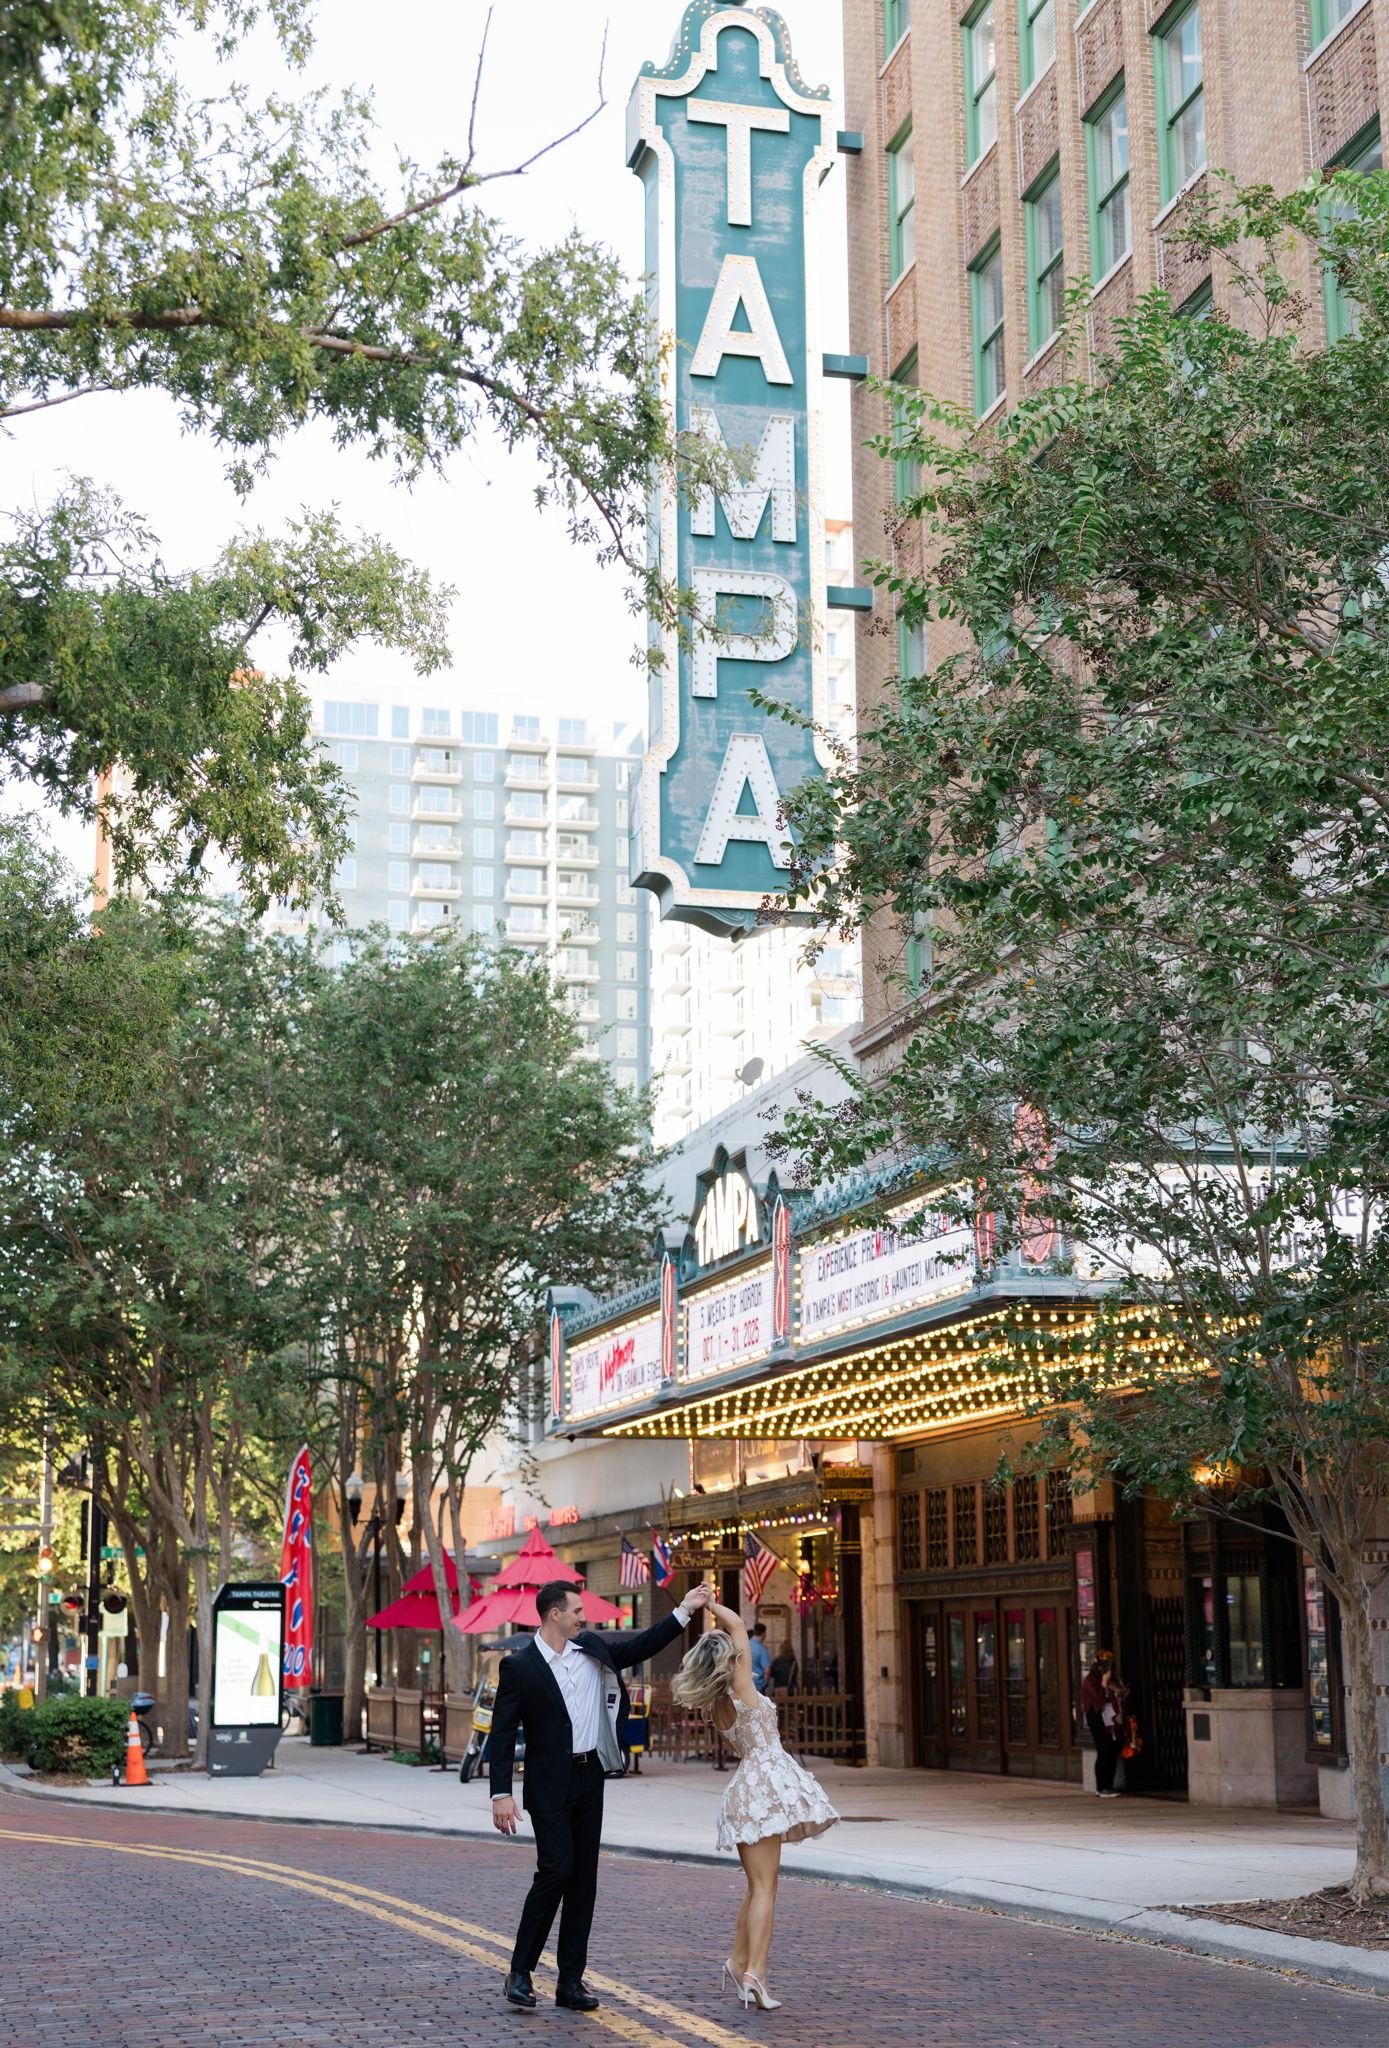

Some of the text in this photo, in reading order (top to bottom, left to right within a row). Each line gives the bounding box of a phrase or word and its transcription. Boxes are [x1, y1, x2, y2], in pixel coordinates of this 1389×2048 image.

[686, 97, 797, 868] TAMPA
[695, 1172, 759, 1266] TAMPA
[817, 1228, 895, 1283] EXPERIENCE PREMIUM
[700, 1282, 762, 1329] 5 WEEKS OF HORROR
[813, 1294, 835, 1322] TAMPA'S
[838, 1287, 852, 1313] MOST
[855, 1277, 879, 1308] HISTORIC
[925, 1254, 945, 1280] MOVIE
[744, 1317, 760, 1348] 2025
[647, 1359, 661, 1383] STREE
[231, 1590, 280, 1598] TAMPA THEATRE
